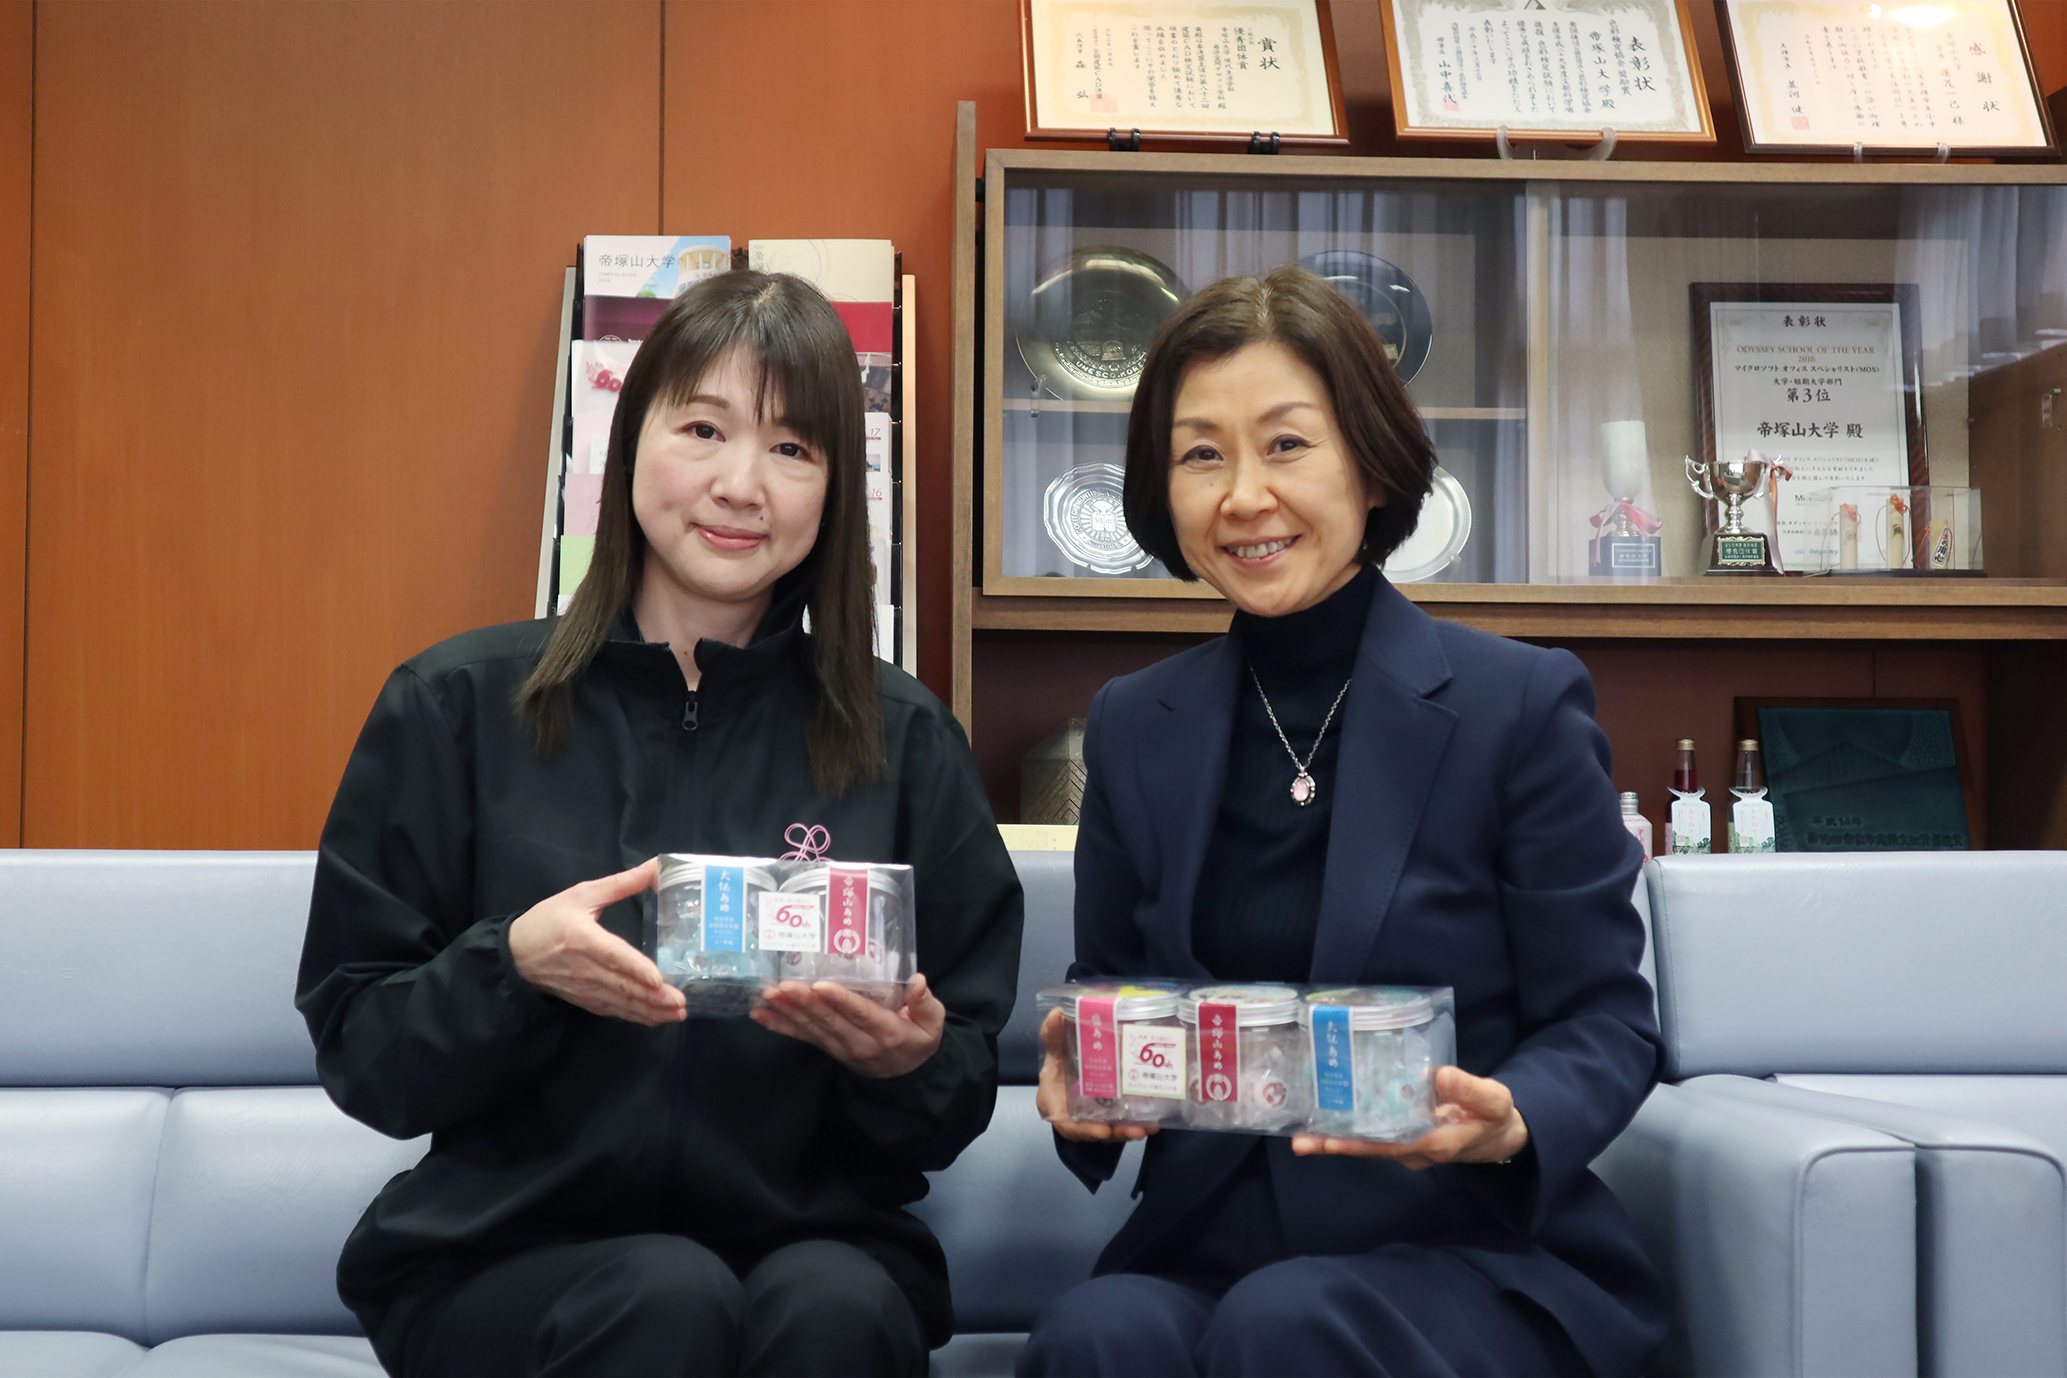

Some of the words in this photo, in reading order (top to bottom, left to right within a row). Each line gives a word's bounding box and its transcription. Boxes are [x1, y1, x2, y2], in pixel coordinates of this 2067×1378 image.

[1233, 27, 1248, 70] 優秀団体賞
[1257, 37, 1281, 70] 賞状
[1075, 60, 1087, 69] 森
[1628, 36, 1657, 91] 表彰状
[1968, 42, 2001, 112] 感謝状
[1077, 90, 1089, 99] 弘
[599, 254, 675, 269] 帝塚山大学
[1783, 314, 1827, 328] 表彰状
[1736, 345, 1776, 354] ODYSSEY
[1777, 345, 1814, 354] SCHOOL
[1816, 345, 1830, 354] OF
[1832, 346, 1850, 355] THE
[1851, 346, 1875, 354] YEAR
[1798, 355, 1816, 363] 2016
[1735, 365, 1780, 373] マイクロソフト
[1782, 365, 1808, 373] オフィス
[1773, 377, 1843, 386] 大学・短期大学部門
[1787, 387, 1831, 403] 第3位
[1757, 421, 1840, 438] 帝塚山大学
[1846, 423, 1863, 439] 殿
[1812, 816, 1862, 827] 平成14年
[719, 869, 730, 913] 大仏あめ
[843, 876, 854, 926] 帝塚山あめ
[778, 932, 816, 940] 帝塚山大学
[1211, 1013, 1224, 1071] 帝塚山あめ
[1326, 1020, 1339, 1069] 大仏あめ
